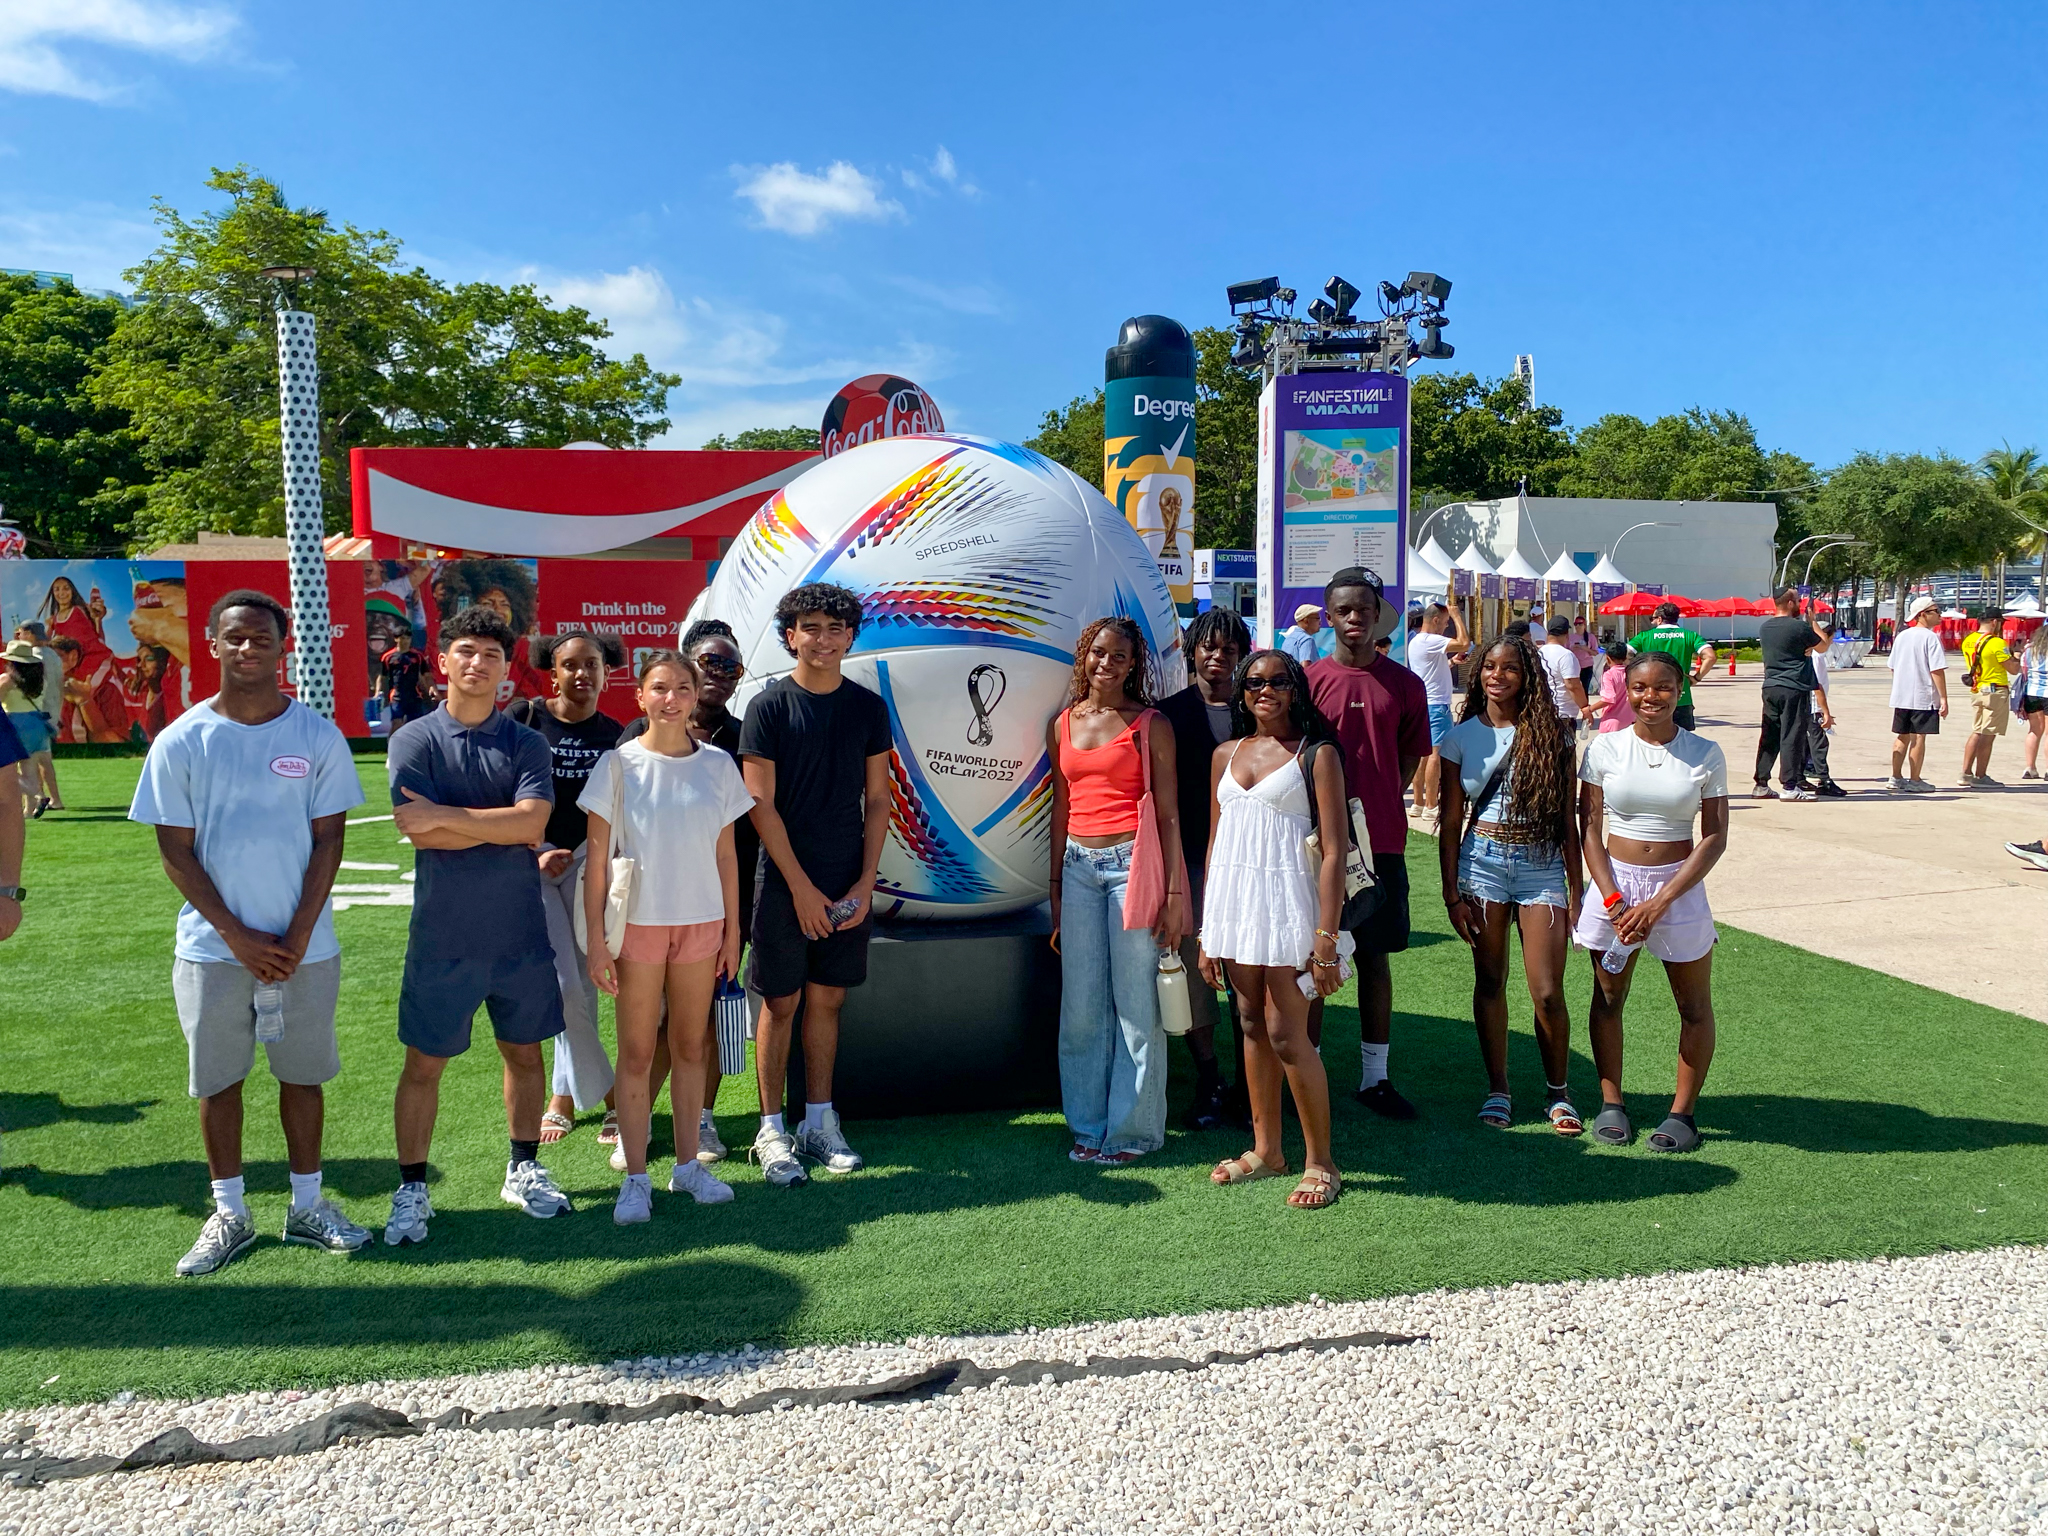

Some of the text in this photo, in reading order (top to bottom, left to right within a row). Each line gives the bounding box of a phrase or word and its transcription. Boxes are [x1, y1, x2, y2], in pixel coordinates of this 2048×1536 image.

[1134, 394, 1196, 422] Degree
[1306, 403, 1379, 415] MIAMI
[825, 385, 943, 460] Coca-Cola
[915, 533, 1000, 561] SPEEDSHELL
[1157, 563, 1183, 576] FIFA
[582, 602, 666, 616] Drink in the
[556, 622, 588, 636] FIFA
[591, 621, 635, 635] World
[637, 621, 667, 637] Cup
[550, 746, 600, 757] NXIETY
[926, 749, 1023, 770] FIFA WORLD CUP
